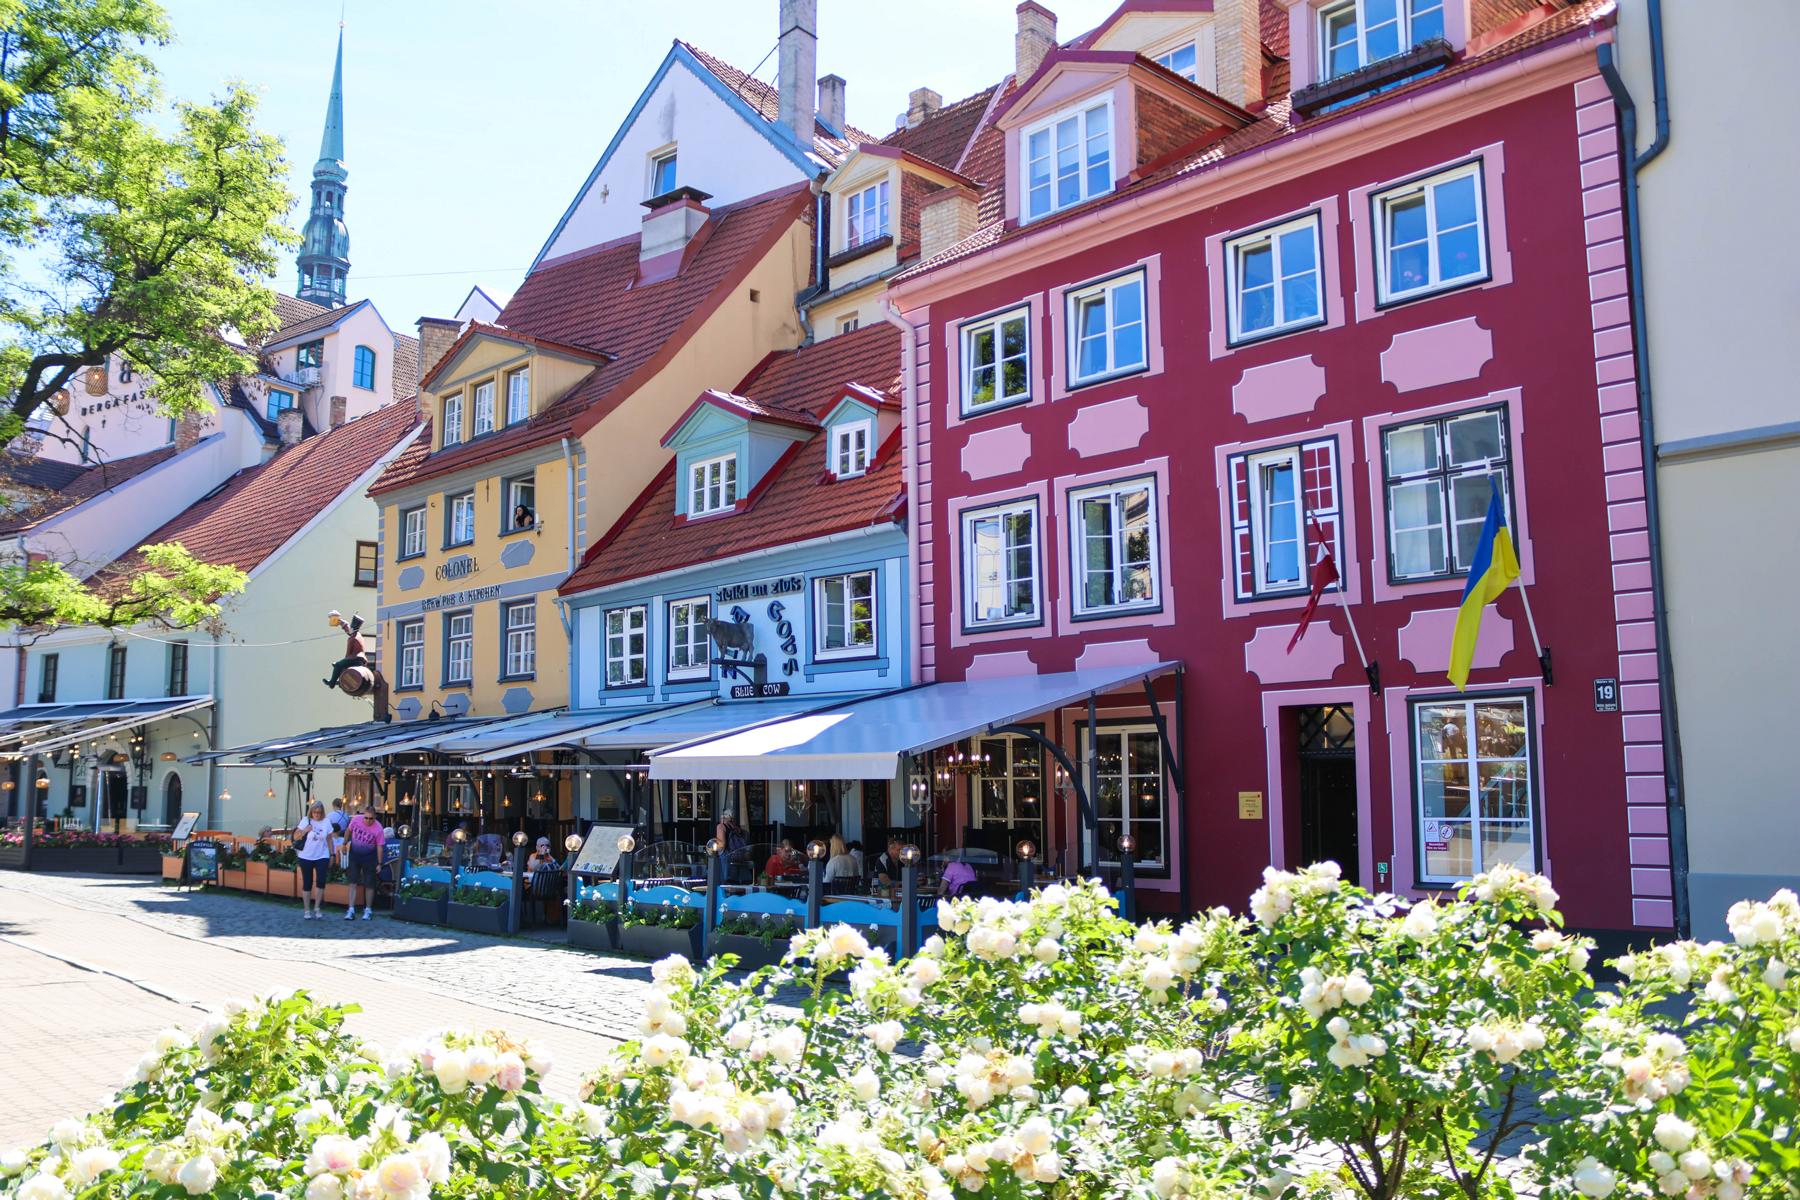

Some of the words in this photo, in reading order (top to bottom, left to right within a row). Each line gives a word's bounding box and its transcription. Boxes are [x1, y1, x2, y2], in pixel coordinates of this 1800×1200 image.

[435, 557, 480, 580] COLONEL
[468, 584, 501, 601] KITCHEN
[734, 685, 754, 698] BLUE
[762, 683, 781, 695] COW
[1597, 685, 1613, 699] 19
